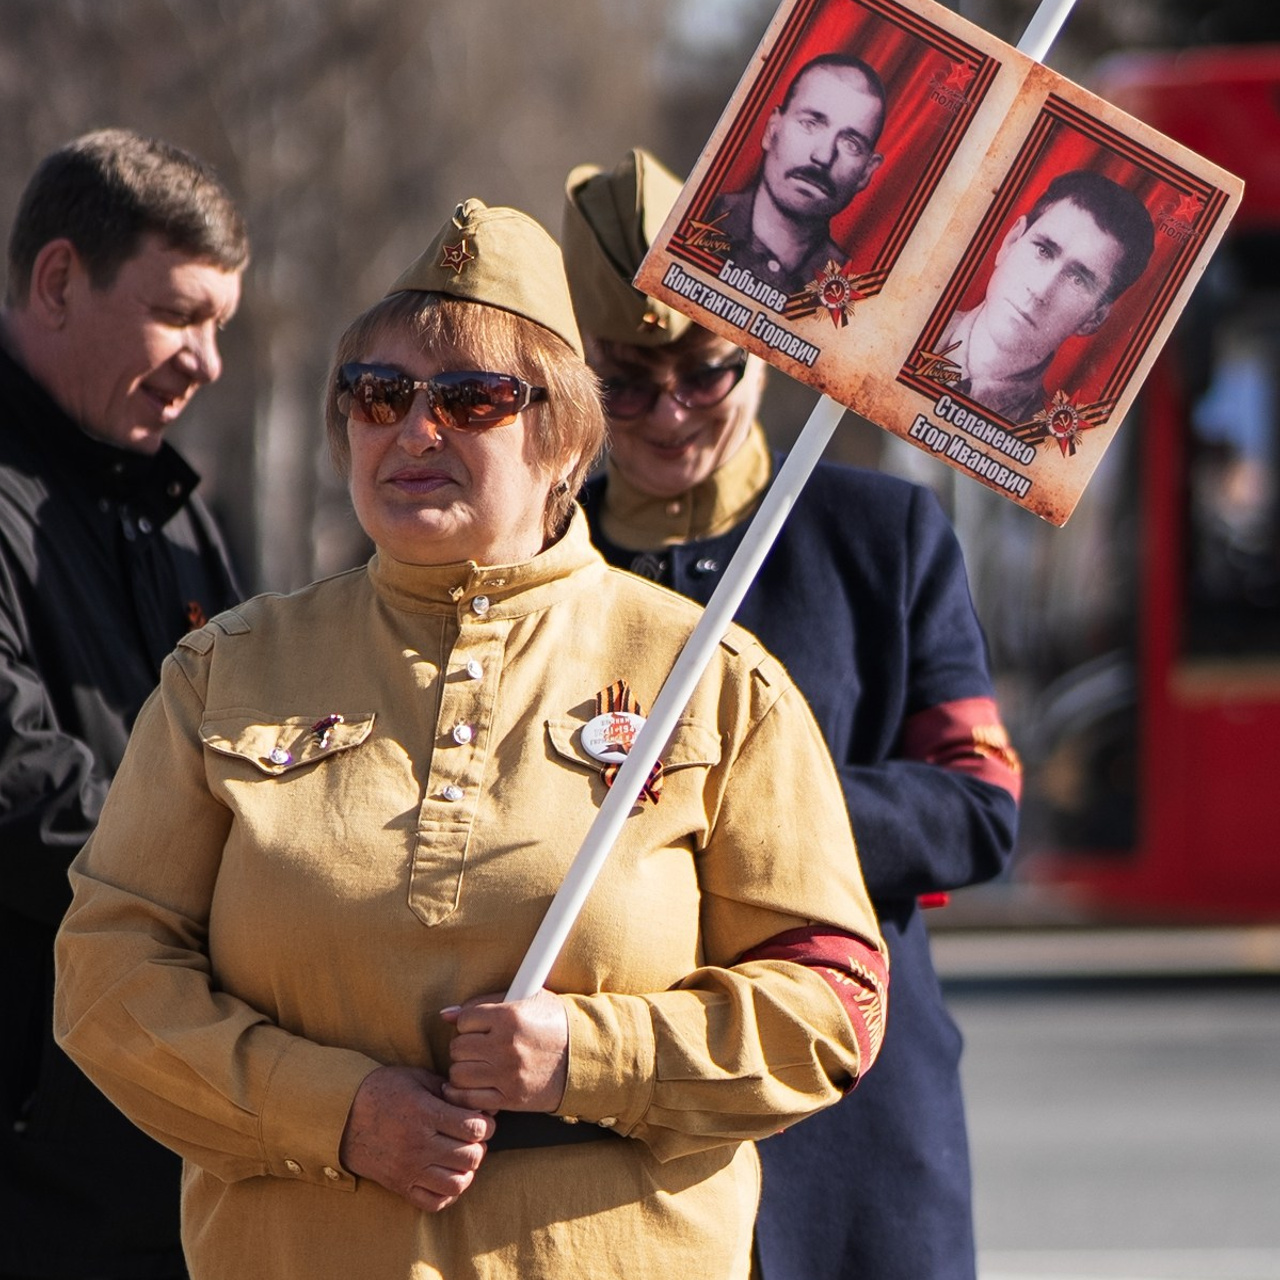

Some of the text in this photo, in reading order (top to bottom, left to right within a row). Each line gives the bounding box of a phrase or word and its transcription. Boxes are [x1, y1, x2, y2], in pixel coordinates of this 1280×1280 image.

[662, 263, 753, 329] Константин
[749, 313, 820, 367] Егорович
[718, 259, 789, 313] Бобылев
[909, 414, 1031, 498] Егор Иванович
[934, 395, 1036, 465] Степаненко
